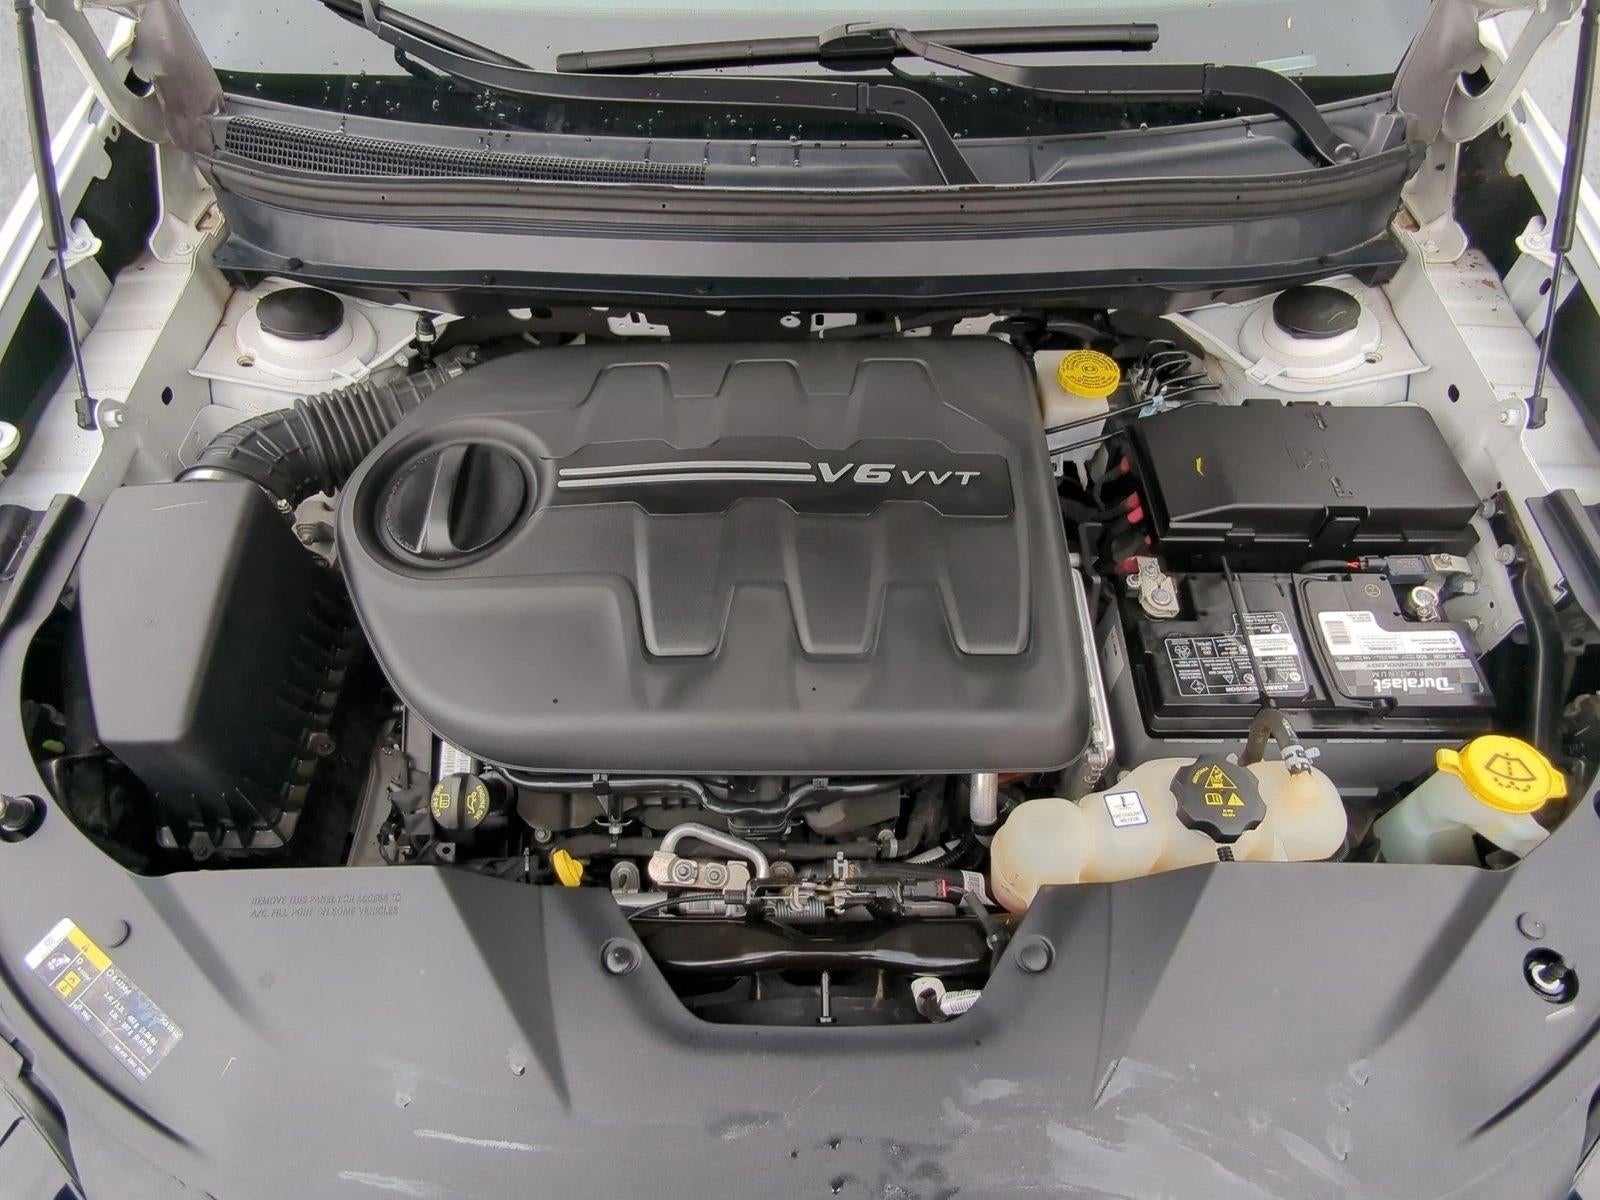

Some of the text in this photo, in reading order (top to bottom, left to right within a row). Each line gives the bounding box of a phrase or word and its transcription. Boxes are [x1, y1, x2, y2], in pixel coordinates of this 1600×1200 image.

[818, 462, 981, 485] V6 VVT
[1372, 669, 1425, 677] PLATINUM
[1374, 677, 1455, 692] Duralast
[473, 785, 486, 820] ENGINE OIL
[251, 896, 286, 905] REMOVE
[337, 895, 355, 903] FOR
[357, 894, 389, 903] ACCESS
[330, 907, 355, 916] SOME
[359, 906, 399, 916] VEHICLES
